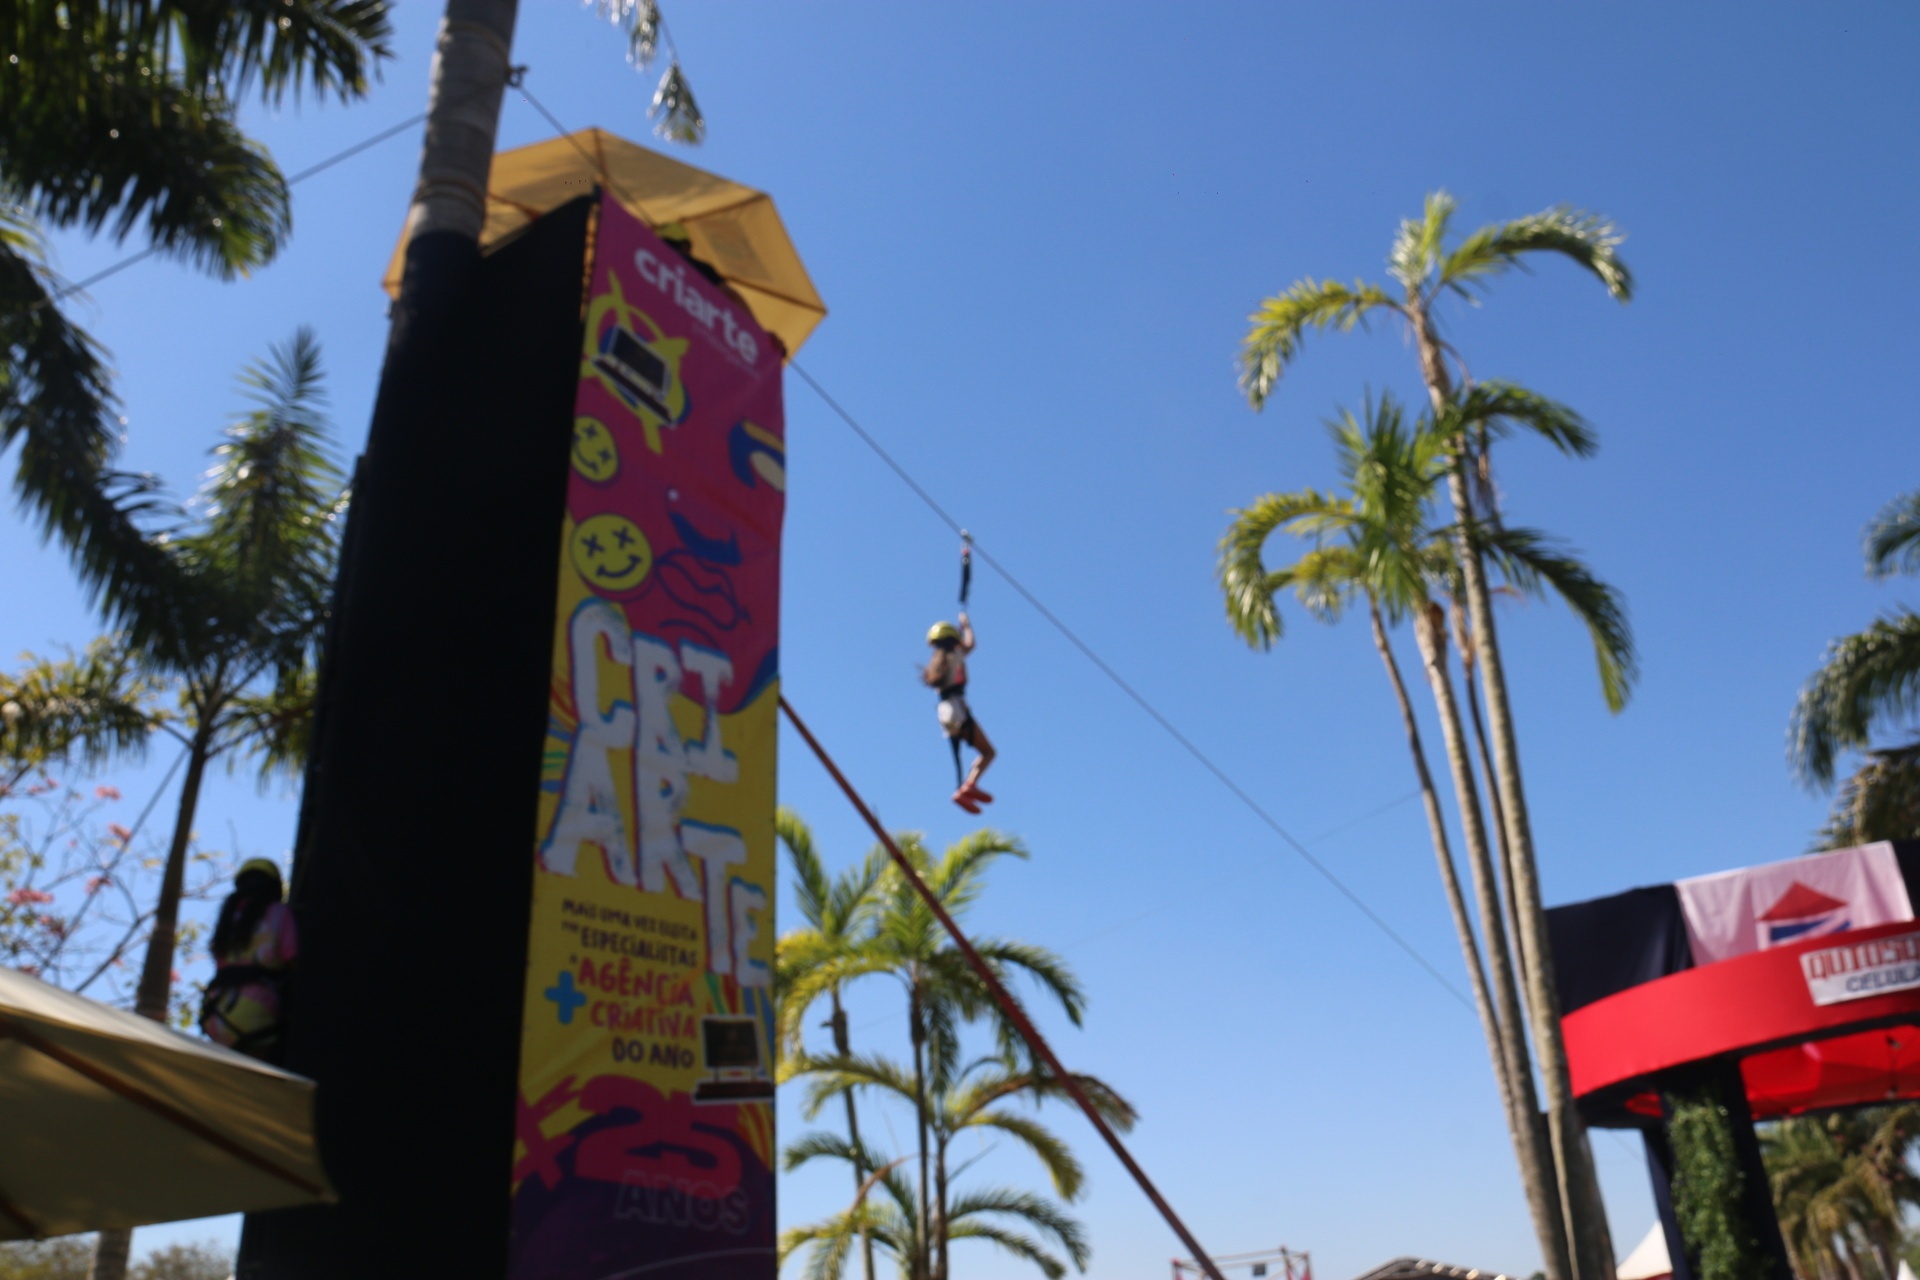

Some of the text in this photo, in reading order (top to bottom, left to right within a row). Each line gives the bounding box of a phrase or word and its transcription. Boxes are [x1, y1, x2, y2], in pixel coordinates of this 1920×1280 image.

[634, 248, 759, 366] criarte
[613, 1036, 694, 1069] DO ANO
[614, 1168, 750, 1236] ANOS
